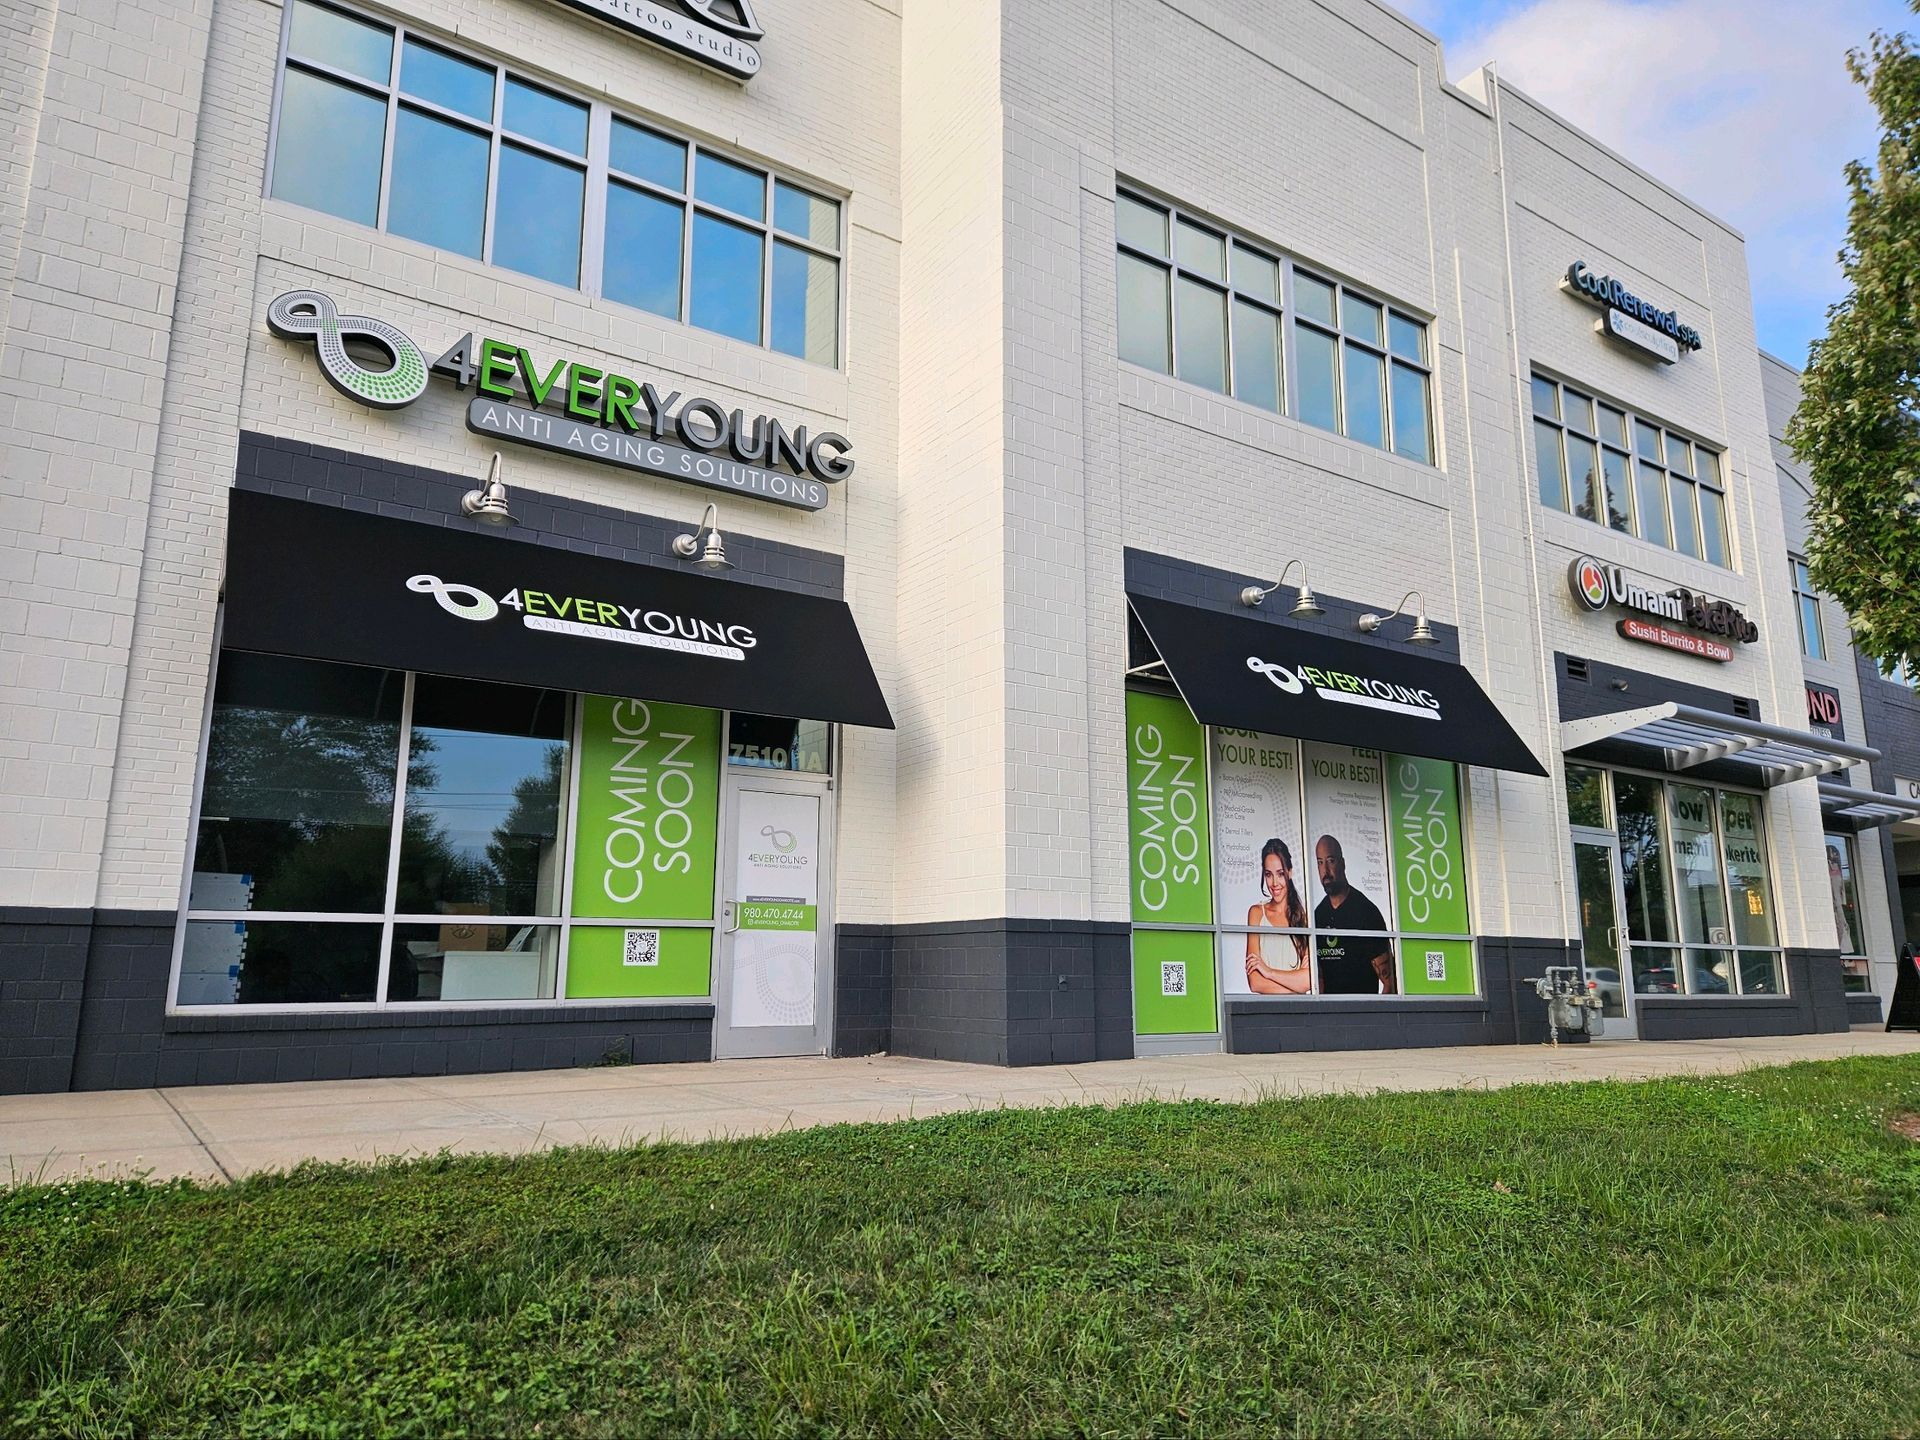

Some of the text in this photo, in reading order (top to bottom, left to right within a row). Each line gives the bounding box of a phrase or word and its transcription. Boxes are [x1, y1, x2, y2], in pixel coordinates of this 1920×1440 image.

[600, 0, 672, 30] attoo
[686, 28, 757, 67] studio
[481, 405, 820, 503] ANTI AGING SOLUTIONS
[500, 588, 757, 648] 4EVERYOUNG
[531, 618, 740, 659] ANTI AGING SOLUTIONS
[1629, 623, 1730, 661] Sushi Burrito & Bowl
[1804, 688, 1839, 724] ND
[729, 743, 788, 769] 7510
[1217, 743, 1293, 770] YOUR BEST!
[1311, 759, 1380, 785] YOUR BEST!
[604, 699, 650, 903] COMING
[653, 731, 696, 874] SOON
[1135, 723, 1168, 911] COMING
[1169, 754, 1199, 885] SOON
[1721, 803, 1753, 832] pen
[748, 853, 808, 865] 4EVERYOUNG
[1400, 762, 1430, 923] COMING
[1425, 788, 1452, 900] SOON
[744, 908, 804, 919] 980.470.4744
